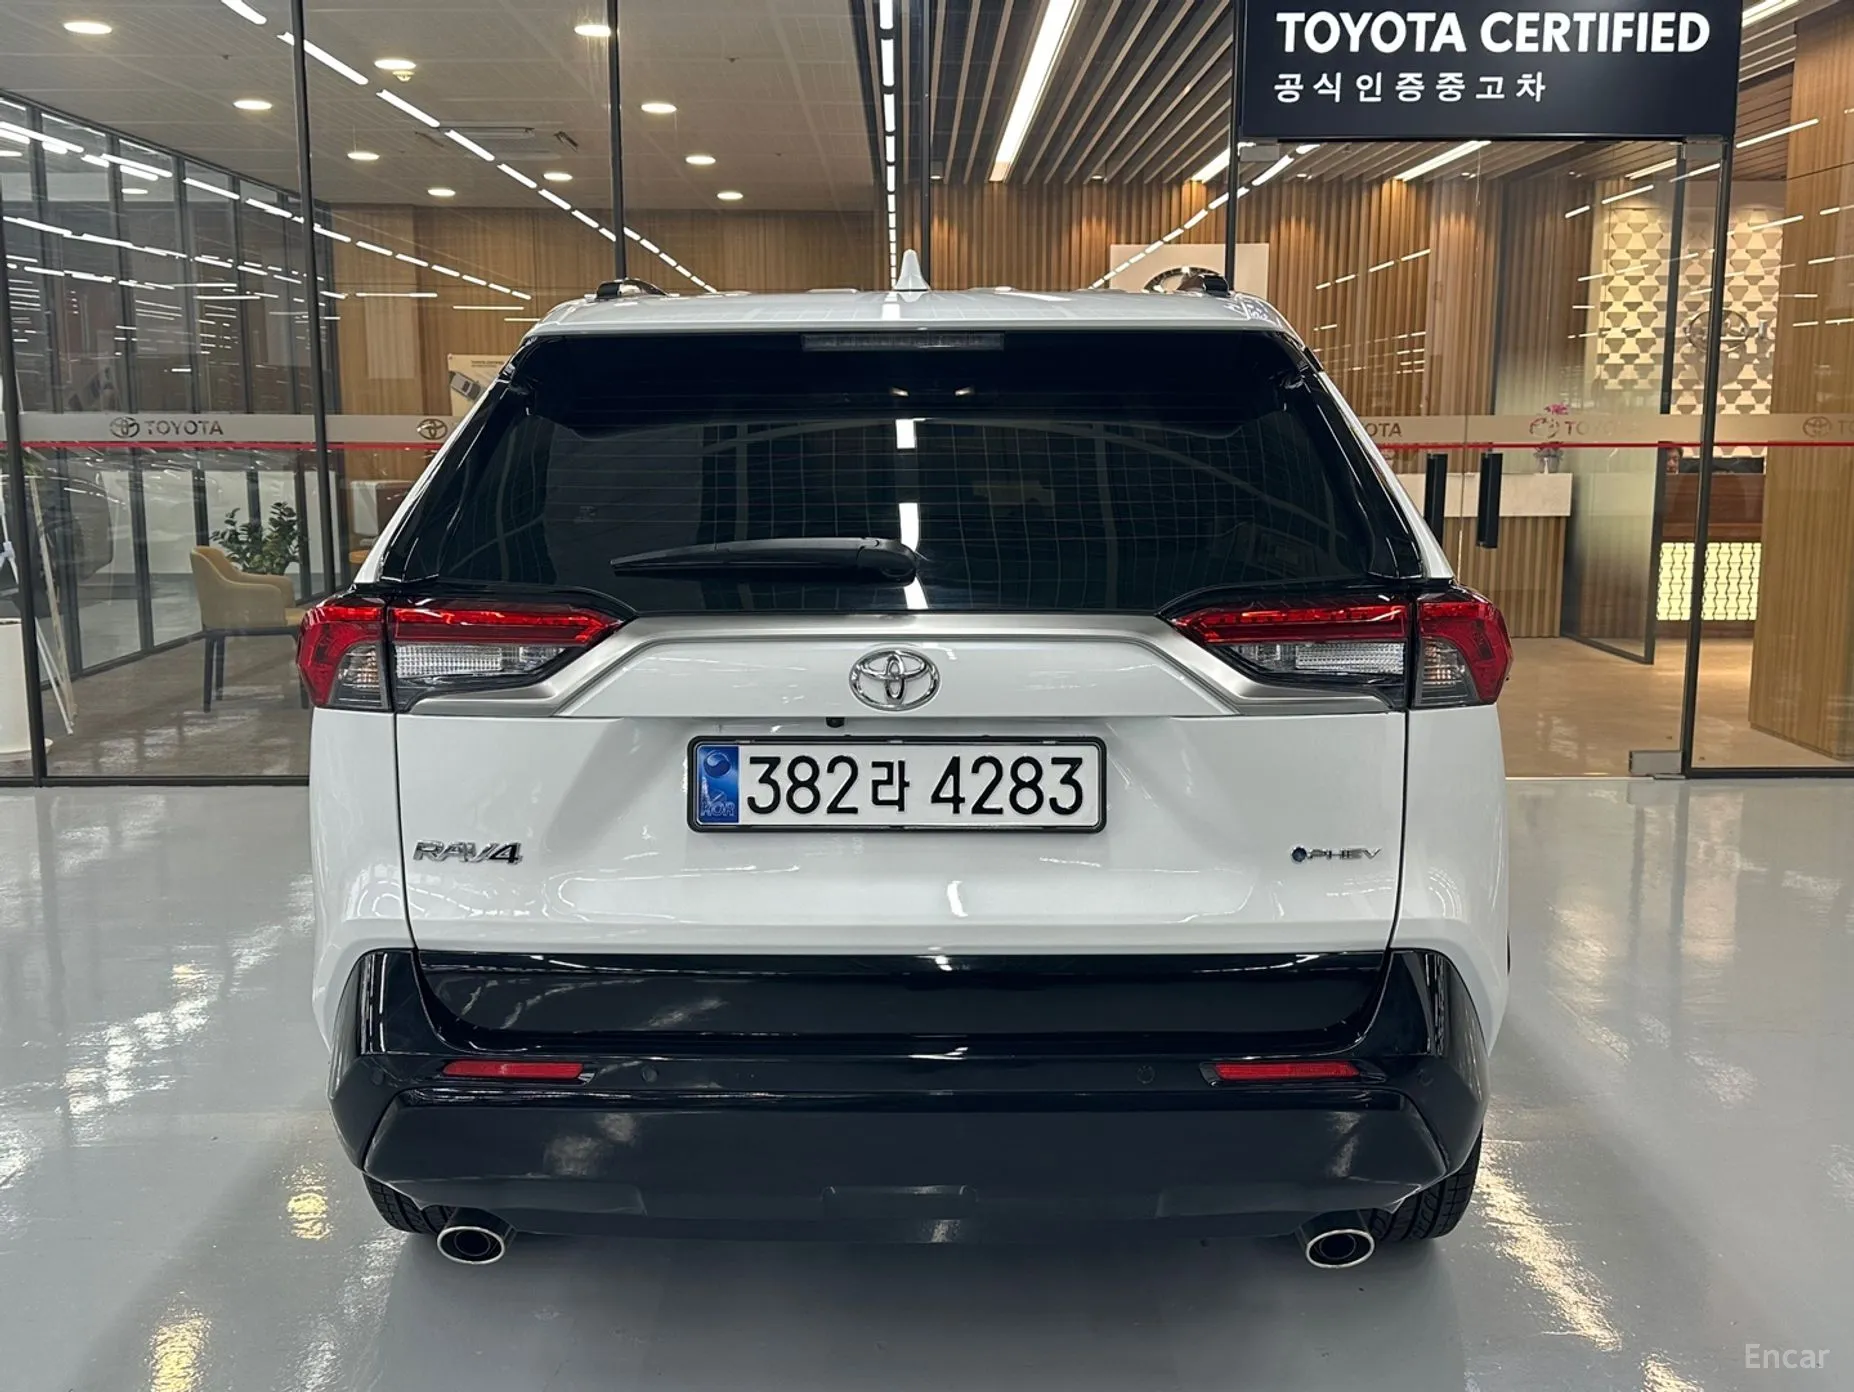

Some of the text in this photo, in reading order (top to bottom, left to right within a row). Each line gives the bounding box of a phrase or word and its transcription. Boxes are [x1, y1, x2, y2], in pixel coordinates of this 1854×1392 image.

[1276, 11, 1711, 53] TOYOTA CERTIFIED
[144, 420, 224, 435] TOYOTA
[1363, 422, 1402, 437] OTA
[747, 755, 1083, 815] 382라 4283
[413, 841, 523, 864] RAV4
[1307, 848, 1381, 860] PHEV
